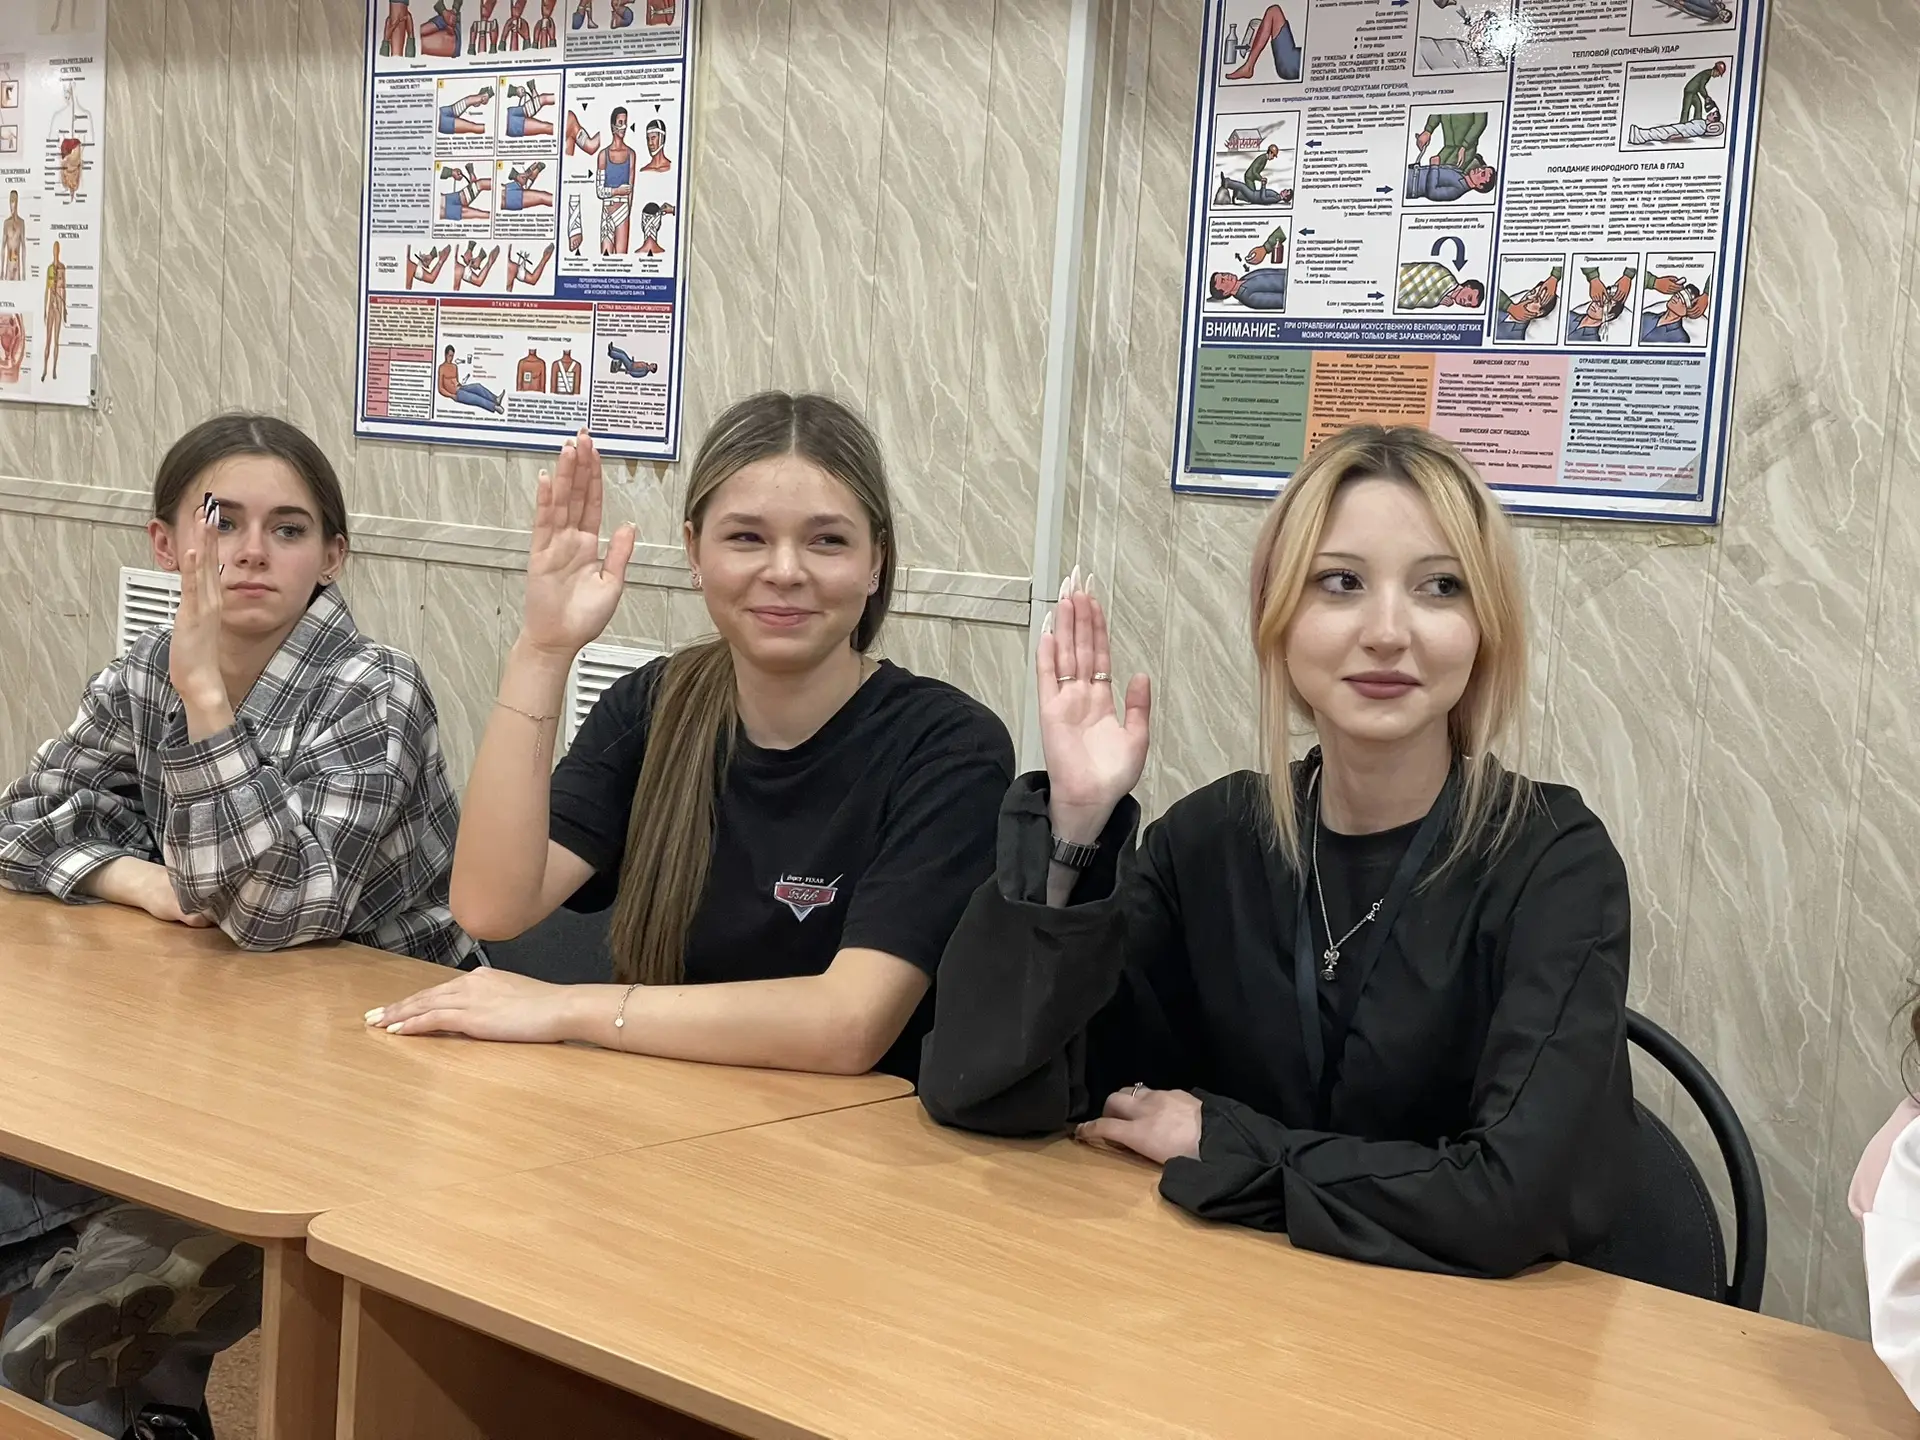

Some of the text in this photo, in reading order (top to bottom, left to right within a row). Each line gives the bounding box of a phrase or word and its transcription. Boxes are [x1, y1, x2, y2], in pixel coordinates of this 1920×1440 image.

[1573, 45, 1679, 58] ТЕПЛОВОЙ (СОЛНЕЧНЫЙ) УДАР
[60, 65, 82, 74] СИСТЕМА
[1304, 82, 1409, 94] ОТРАВЛЕНИЕ ПРОДУКТАМИ ГОРЕНИЯ,
[1547, 165, 1590, 173] ПОПАДАНИЕ
[1591, 164, 1639, 172] ИНОРОДНОГО
[1206, 321, 1280, 338] ВНИМАНИЕ:
[1284, 321, 1296, 329] ПРИ
[1336, 322, 1360, 330] ГАЗАМИ
[1361, 322, 1413, 331] ИСКУССТВЕННУЮ
[1413, 323, 1456, 331] ВЕНТИЛЯЦИЮ
[1457, 323, 1481, 331] ЛЕГКИХ
[1301, 331, 1461, 341] МОЖНО ПРОВОДИТЬ ТОЛЬКО ВНЕ ЗАРАЖЕННОЙ ЗОНЫ
